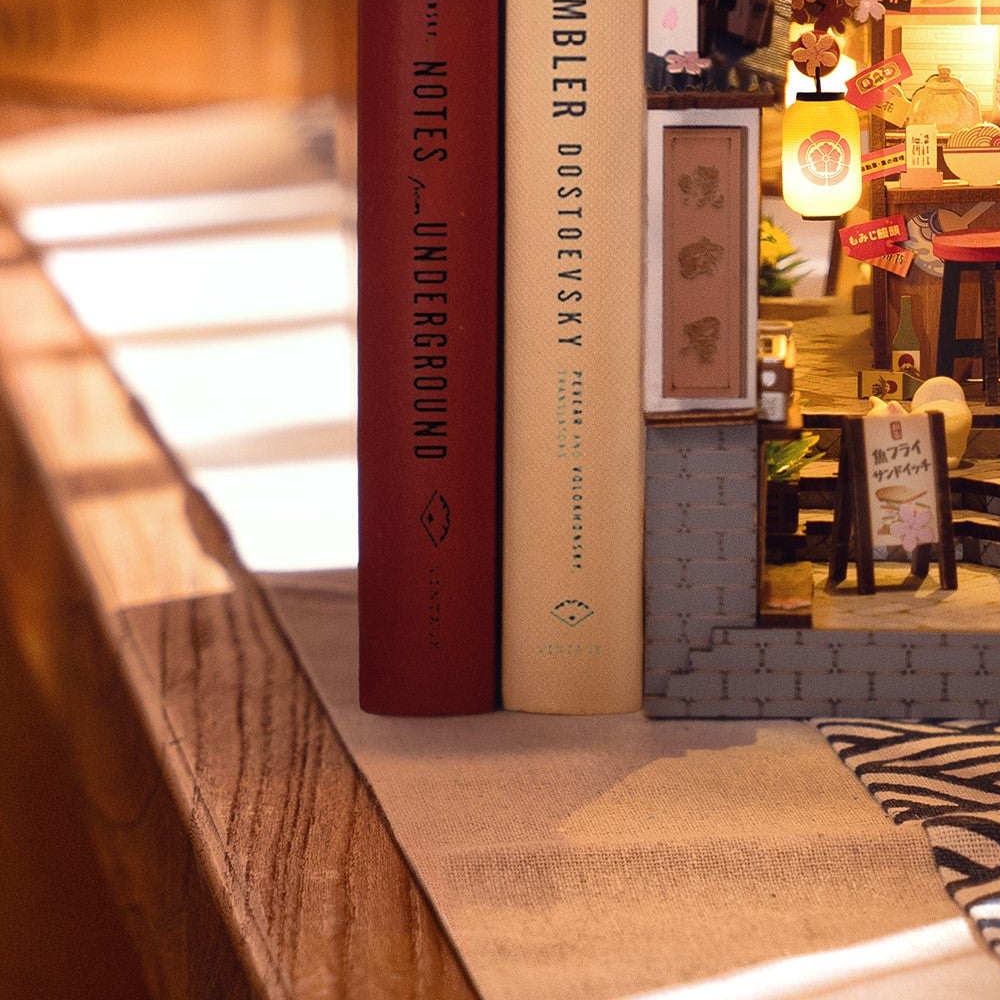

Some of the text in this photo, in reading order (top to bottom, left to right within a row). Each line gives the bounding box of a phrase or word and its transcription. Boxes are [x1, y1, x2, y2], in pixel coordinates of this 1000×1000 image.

[413, 62, 447, 162] NOTES
[413, 223, 447, 460] UNDERGROUND
[557, 143, 583, 348] DOSTOEVSKY
